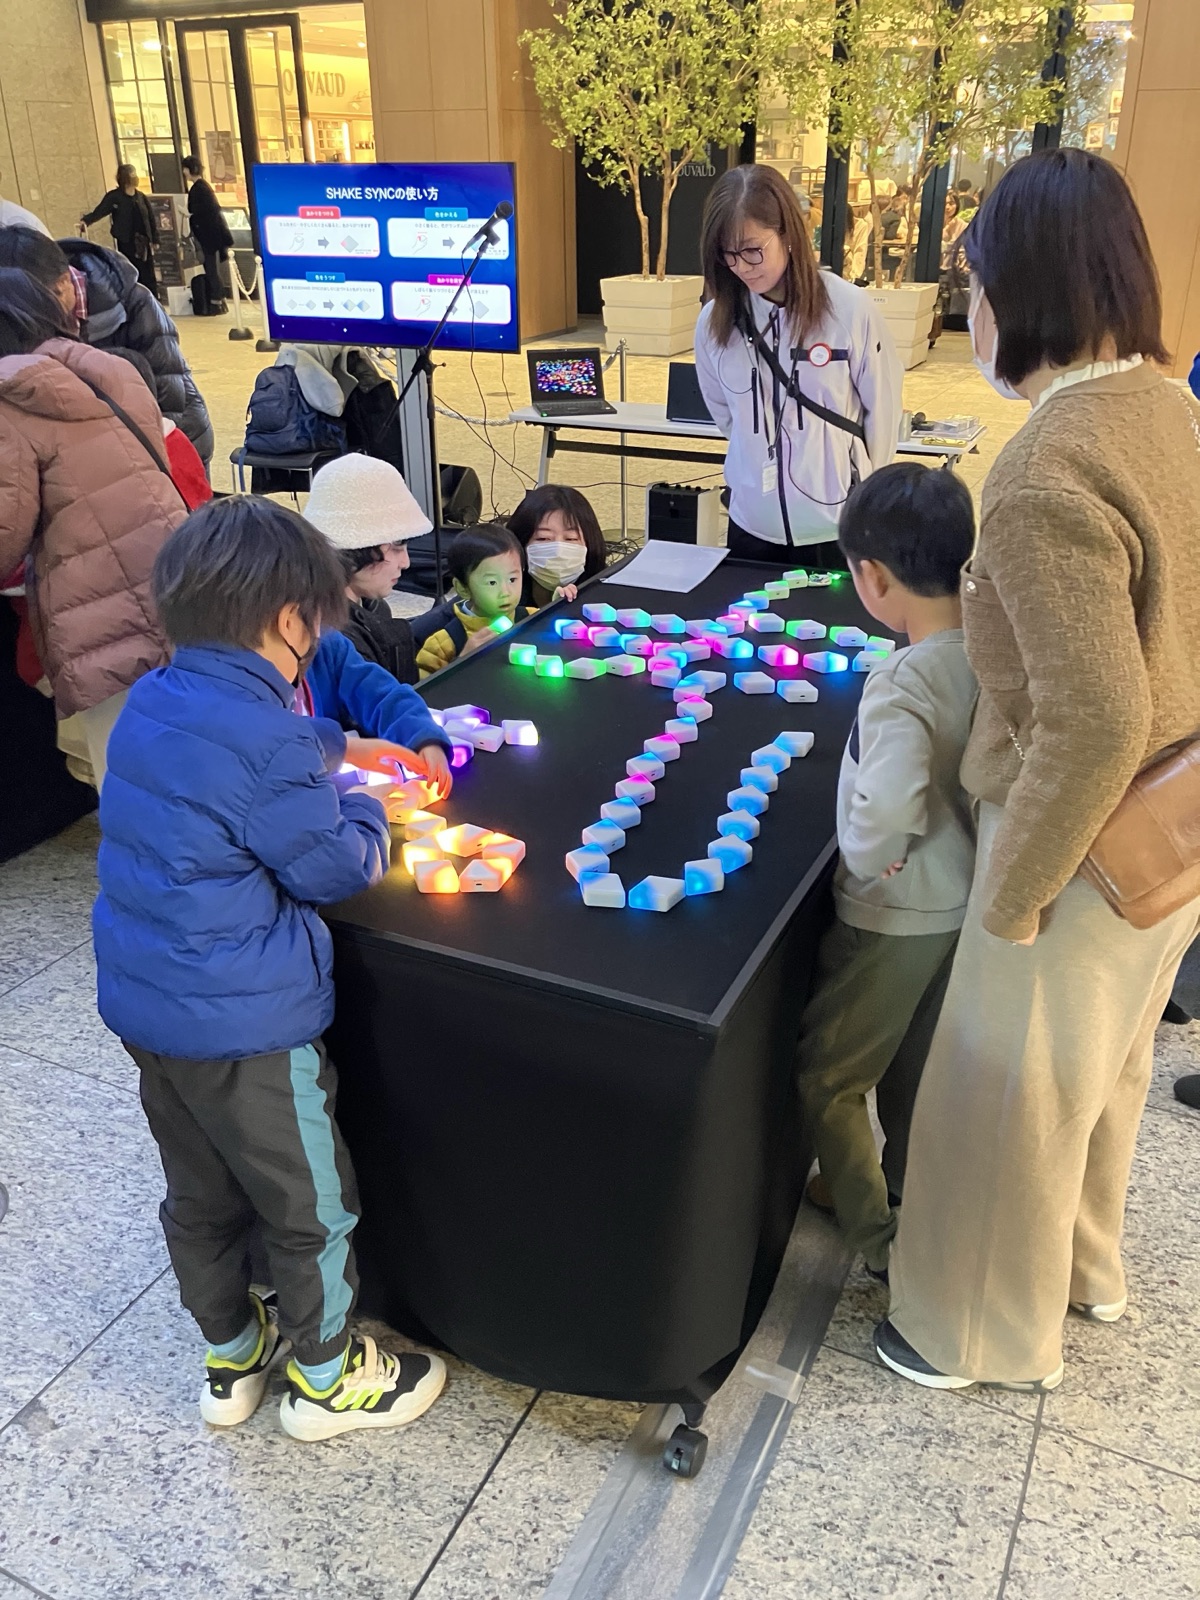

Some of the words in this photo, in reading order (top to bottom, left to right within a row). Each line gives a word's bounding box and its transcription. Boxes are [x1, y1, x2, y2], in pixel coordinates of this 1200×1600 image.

[283, 68, 346, 97] OVAUD
[326, 187, 362, 199] SHAKE
[364, 186, 439, 201] SYNCの使い方
